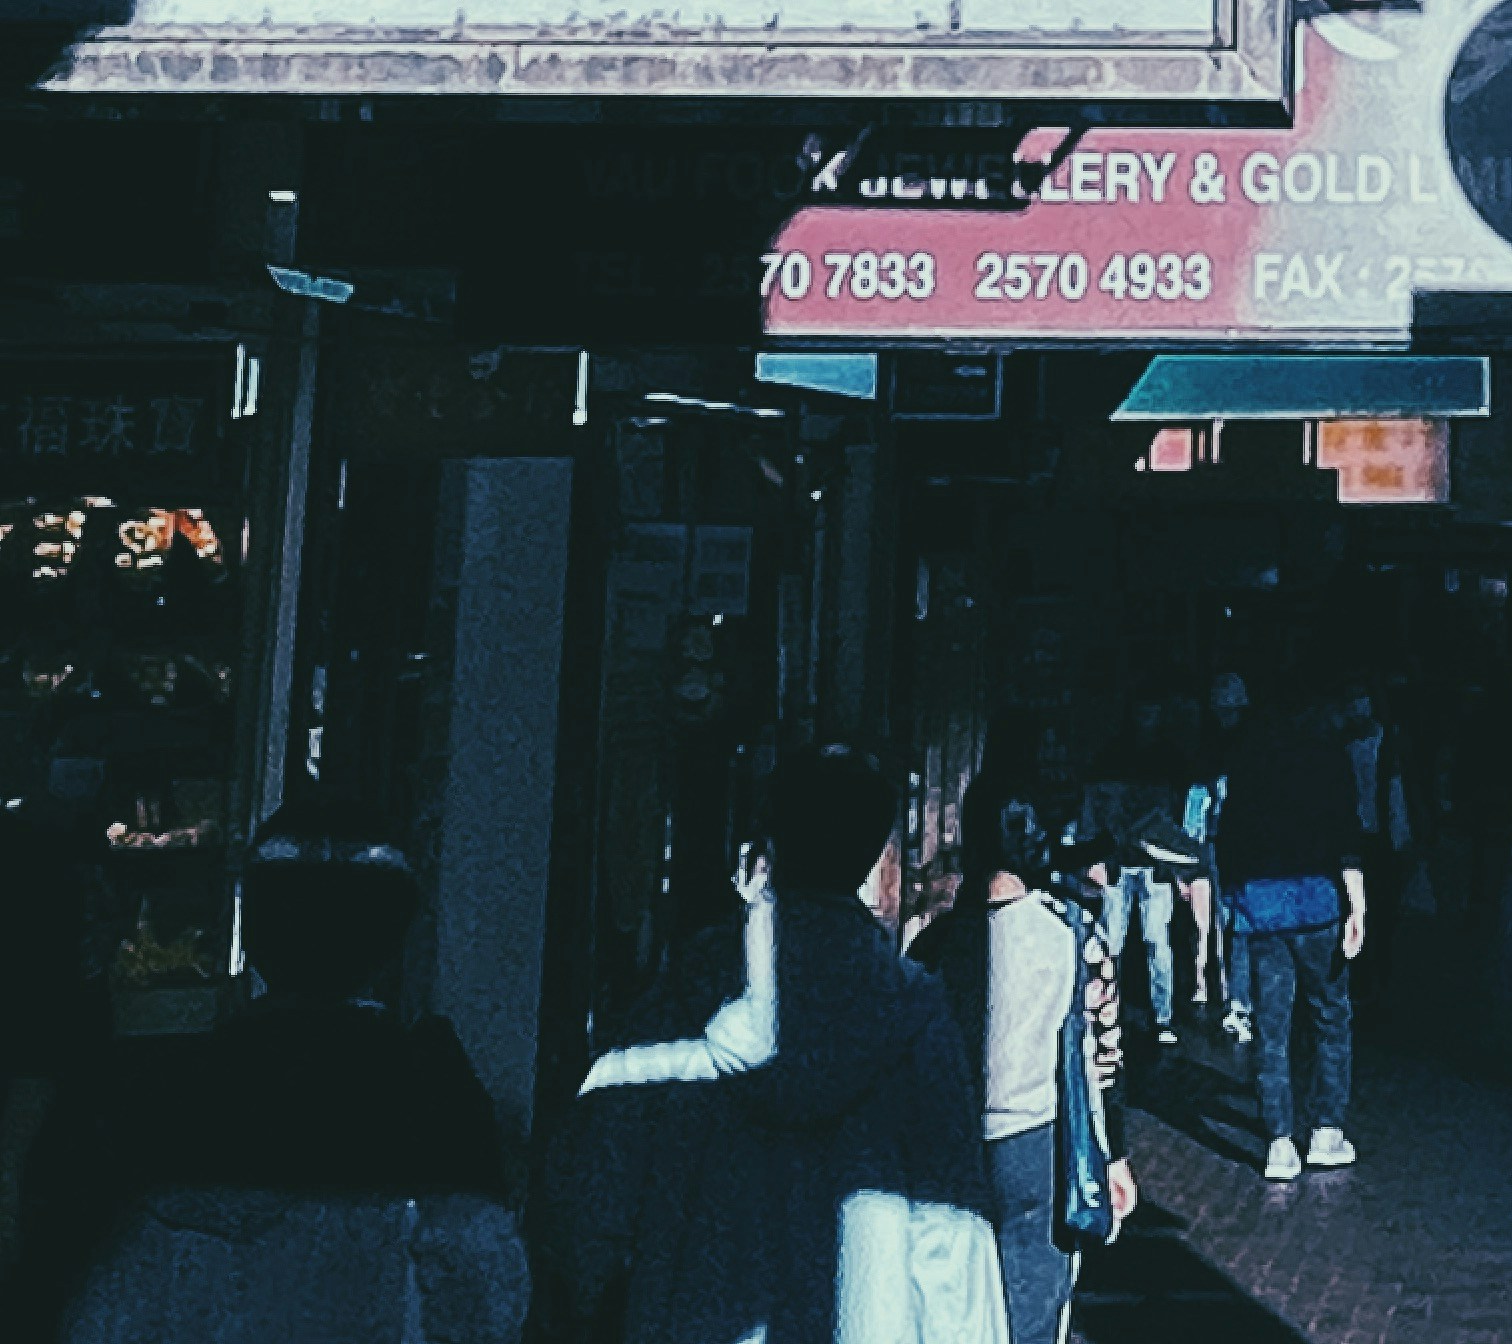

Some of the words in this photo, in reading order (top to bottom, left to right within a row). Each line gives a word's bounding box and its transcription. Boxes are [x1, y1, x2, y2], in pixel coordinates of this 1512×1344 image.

[1189, 153, 1228, 204] &
[1241, 152, 1394, 204] GOLD
[823, 252, 936, 301] 7833
[974, 252, 1089, 301] 2570
[1099, 252, 1213, 301] 4933
[1252, 252, 1347, 301] FAX
